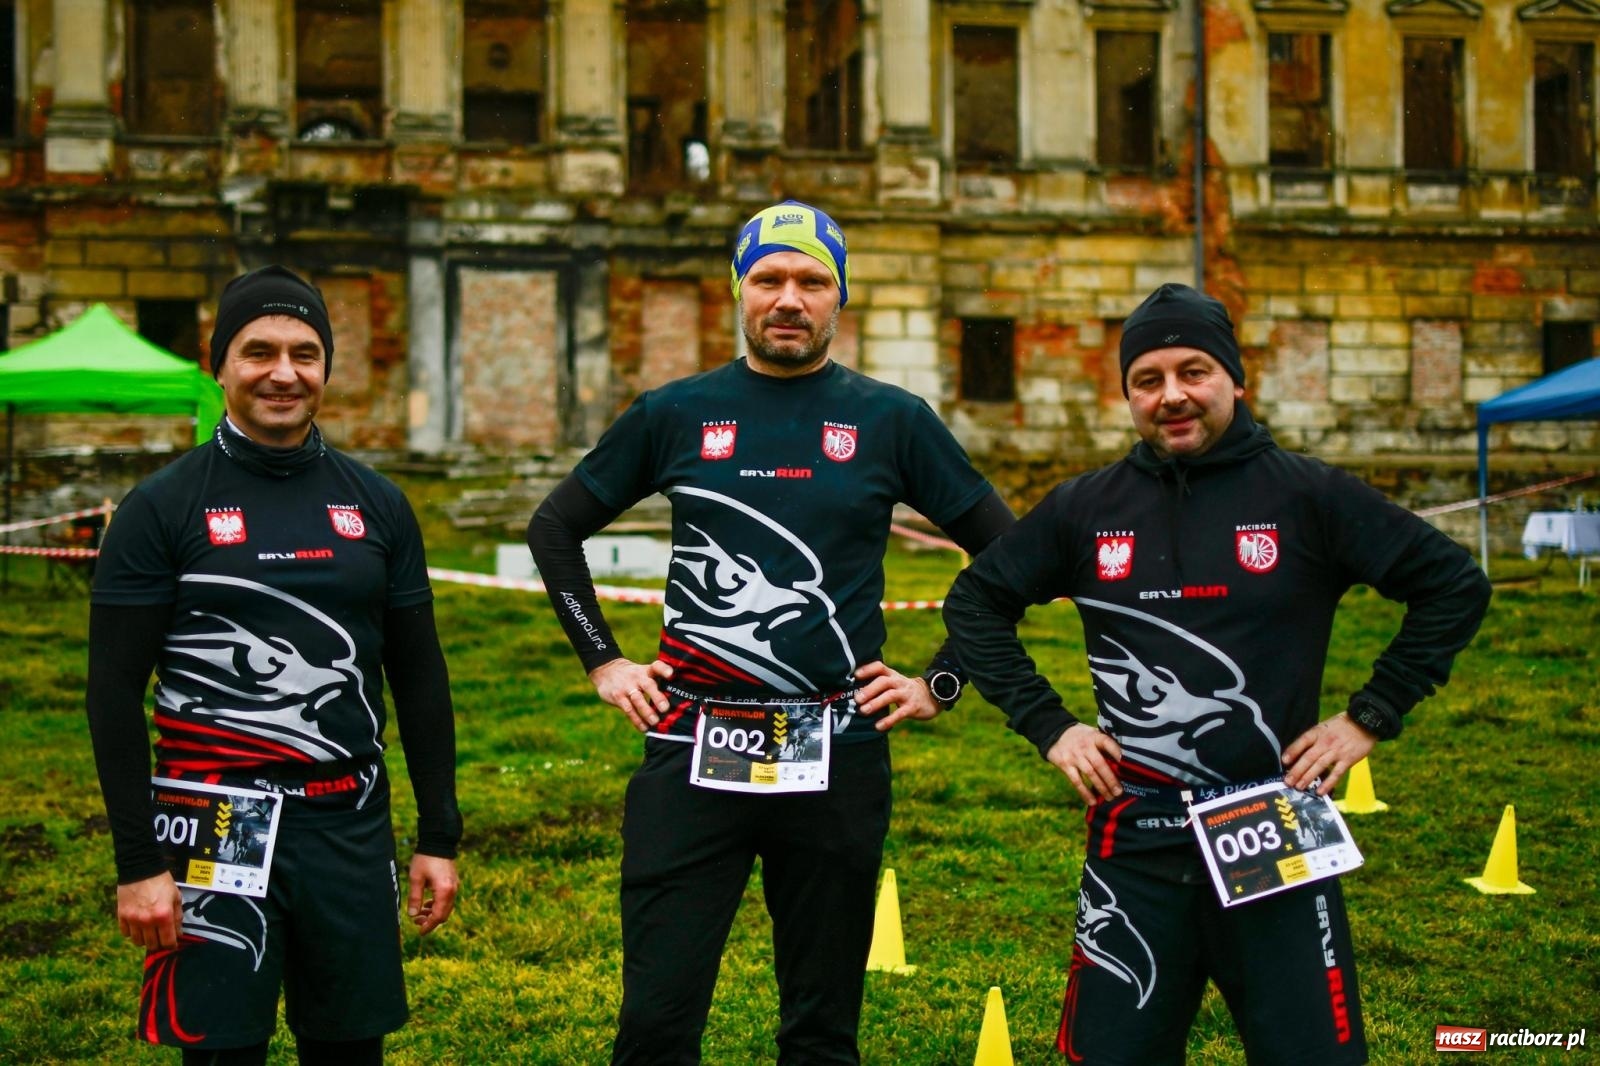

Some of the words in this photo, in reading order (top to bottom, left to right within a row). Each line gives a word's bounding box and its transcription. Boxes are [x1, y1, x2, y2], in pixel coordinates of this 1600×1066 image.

[708, 726, 766, 756] 002
[154, 813, 199, 847] 001
[1216, 821, 1282, 863] 003
